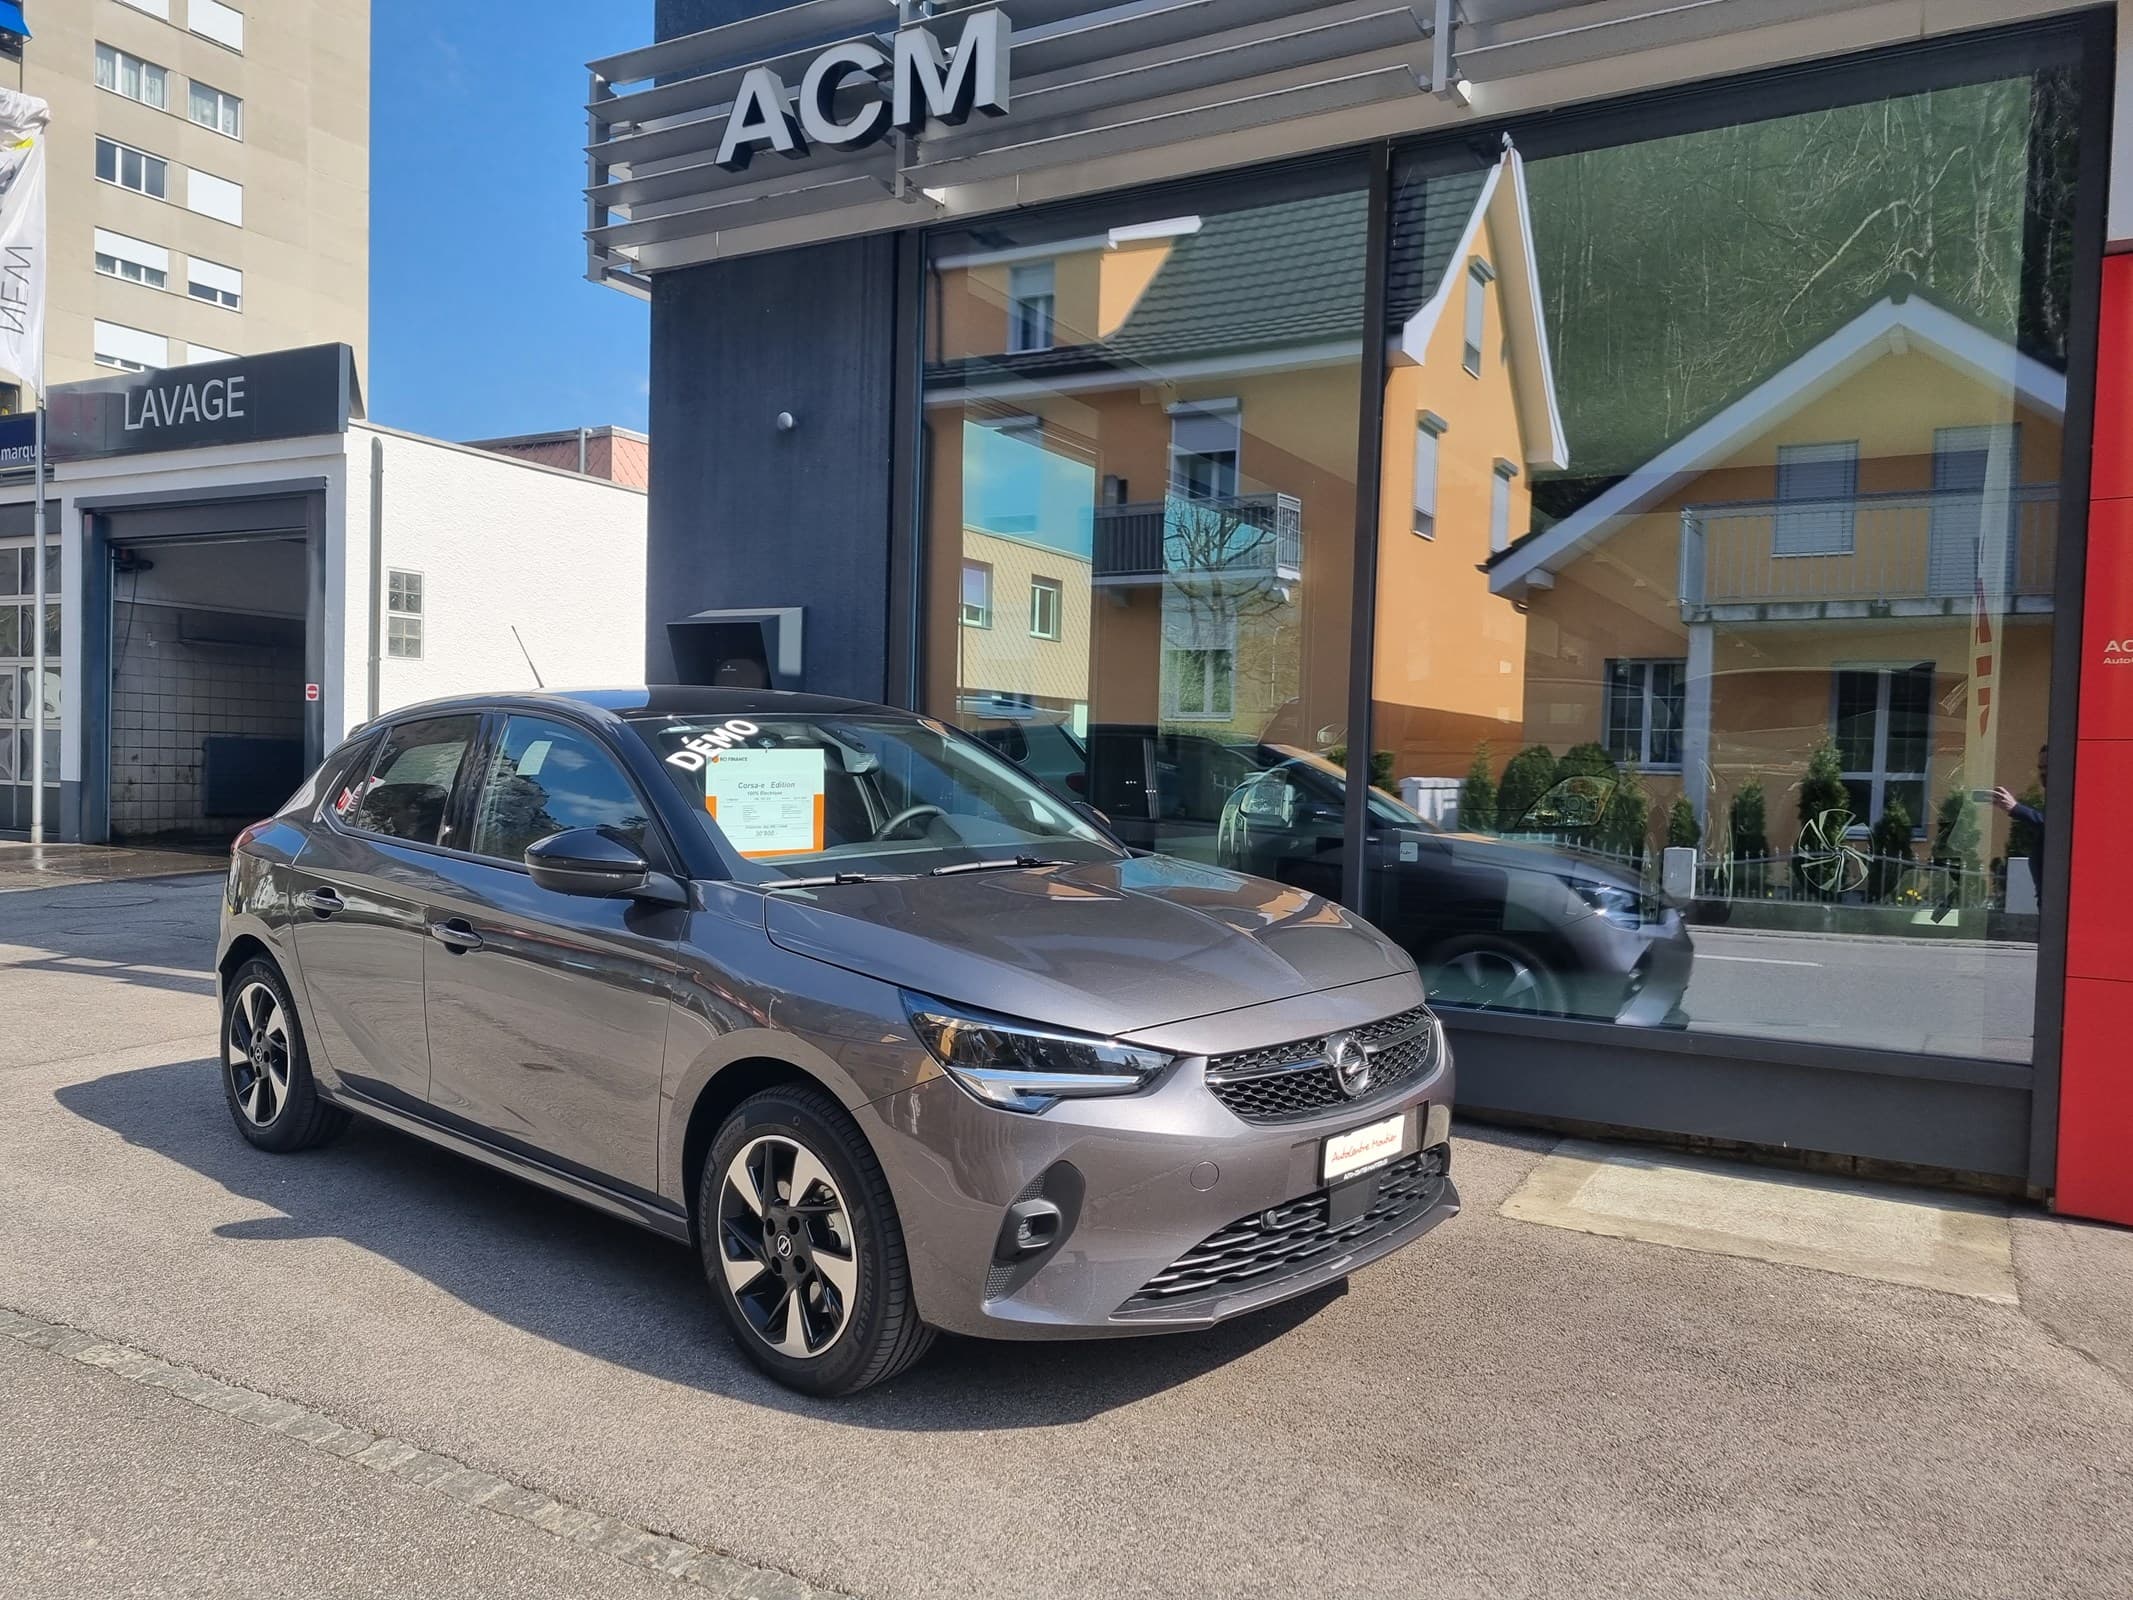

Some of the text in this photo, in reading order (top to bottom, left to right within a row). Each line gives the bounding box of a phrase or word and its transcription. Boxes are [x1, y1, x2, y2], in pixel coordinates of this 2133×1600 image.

[715, 7, 1010, 171] ACM
[124, 375, 245, 430] LAVAGE
[665, 719, 759, 772] DÉMO
[770, 781, 796, 789] Edition
